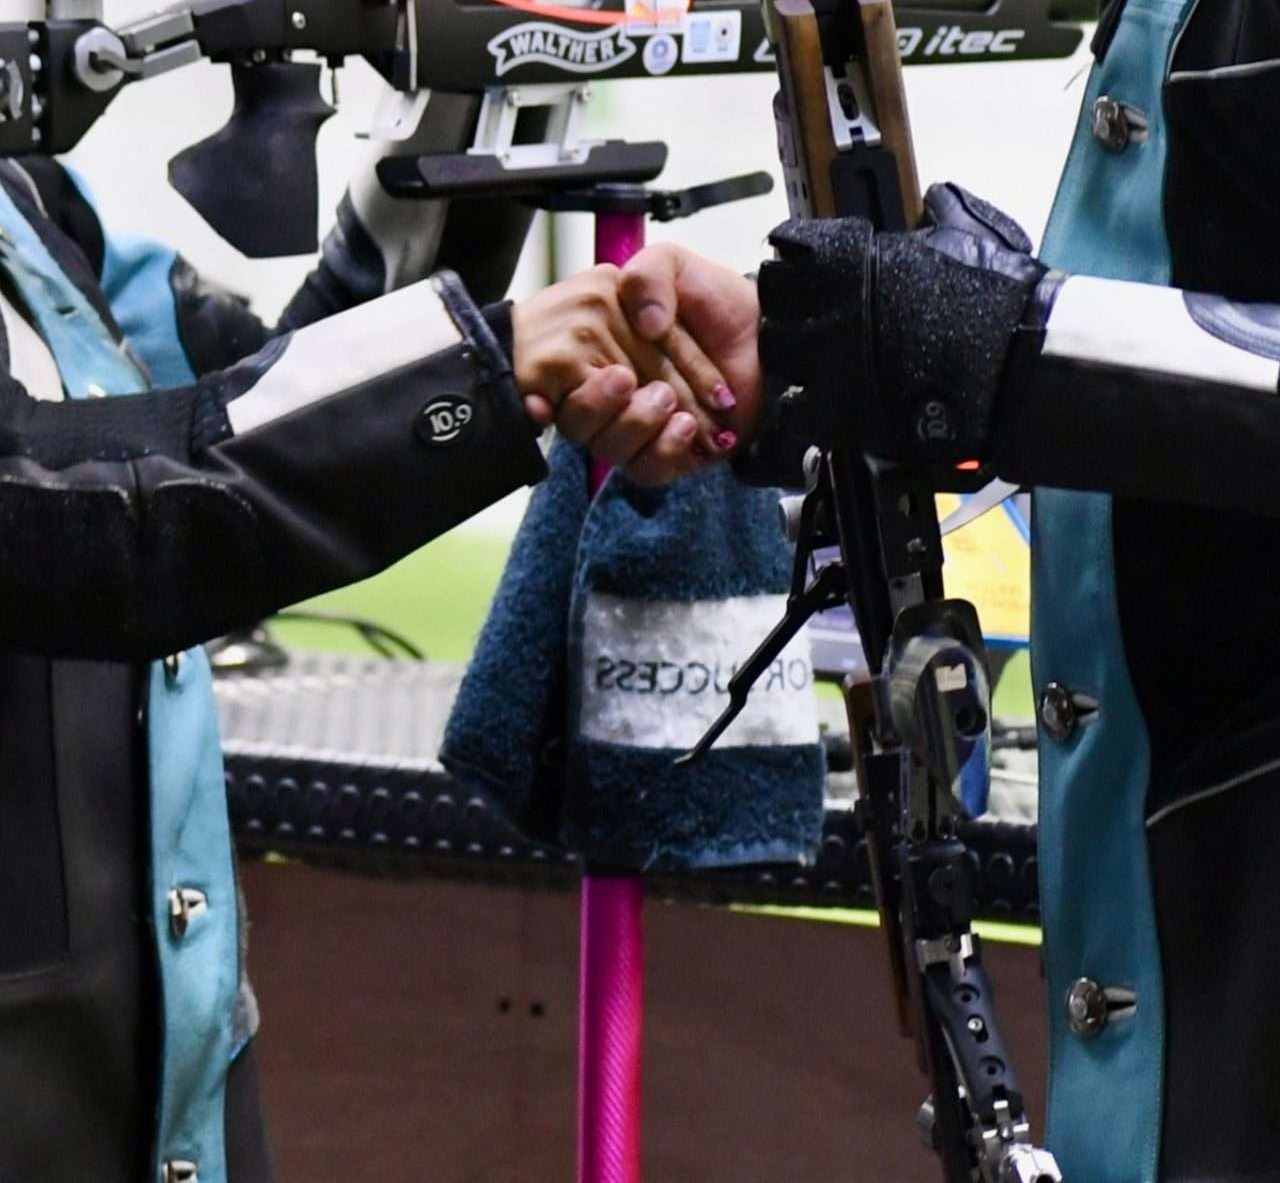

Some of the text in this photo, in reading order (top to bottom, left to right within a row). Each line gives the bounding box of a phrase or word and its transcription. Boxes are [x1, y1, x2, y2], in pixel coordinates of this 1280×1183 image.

[510, 31, 615, 64] WALTHER
[923, 25, 1025, 57] itec
[429, 403, 473, 434] 10.9
